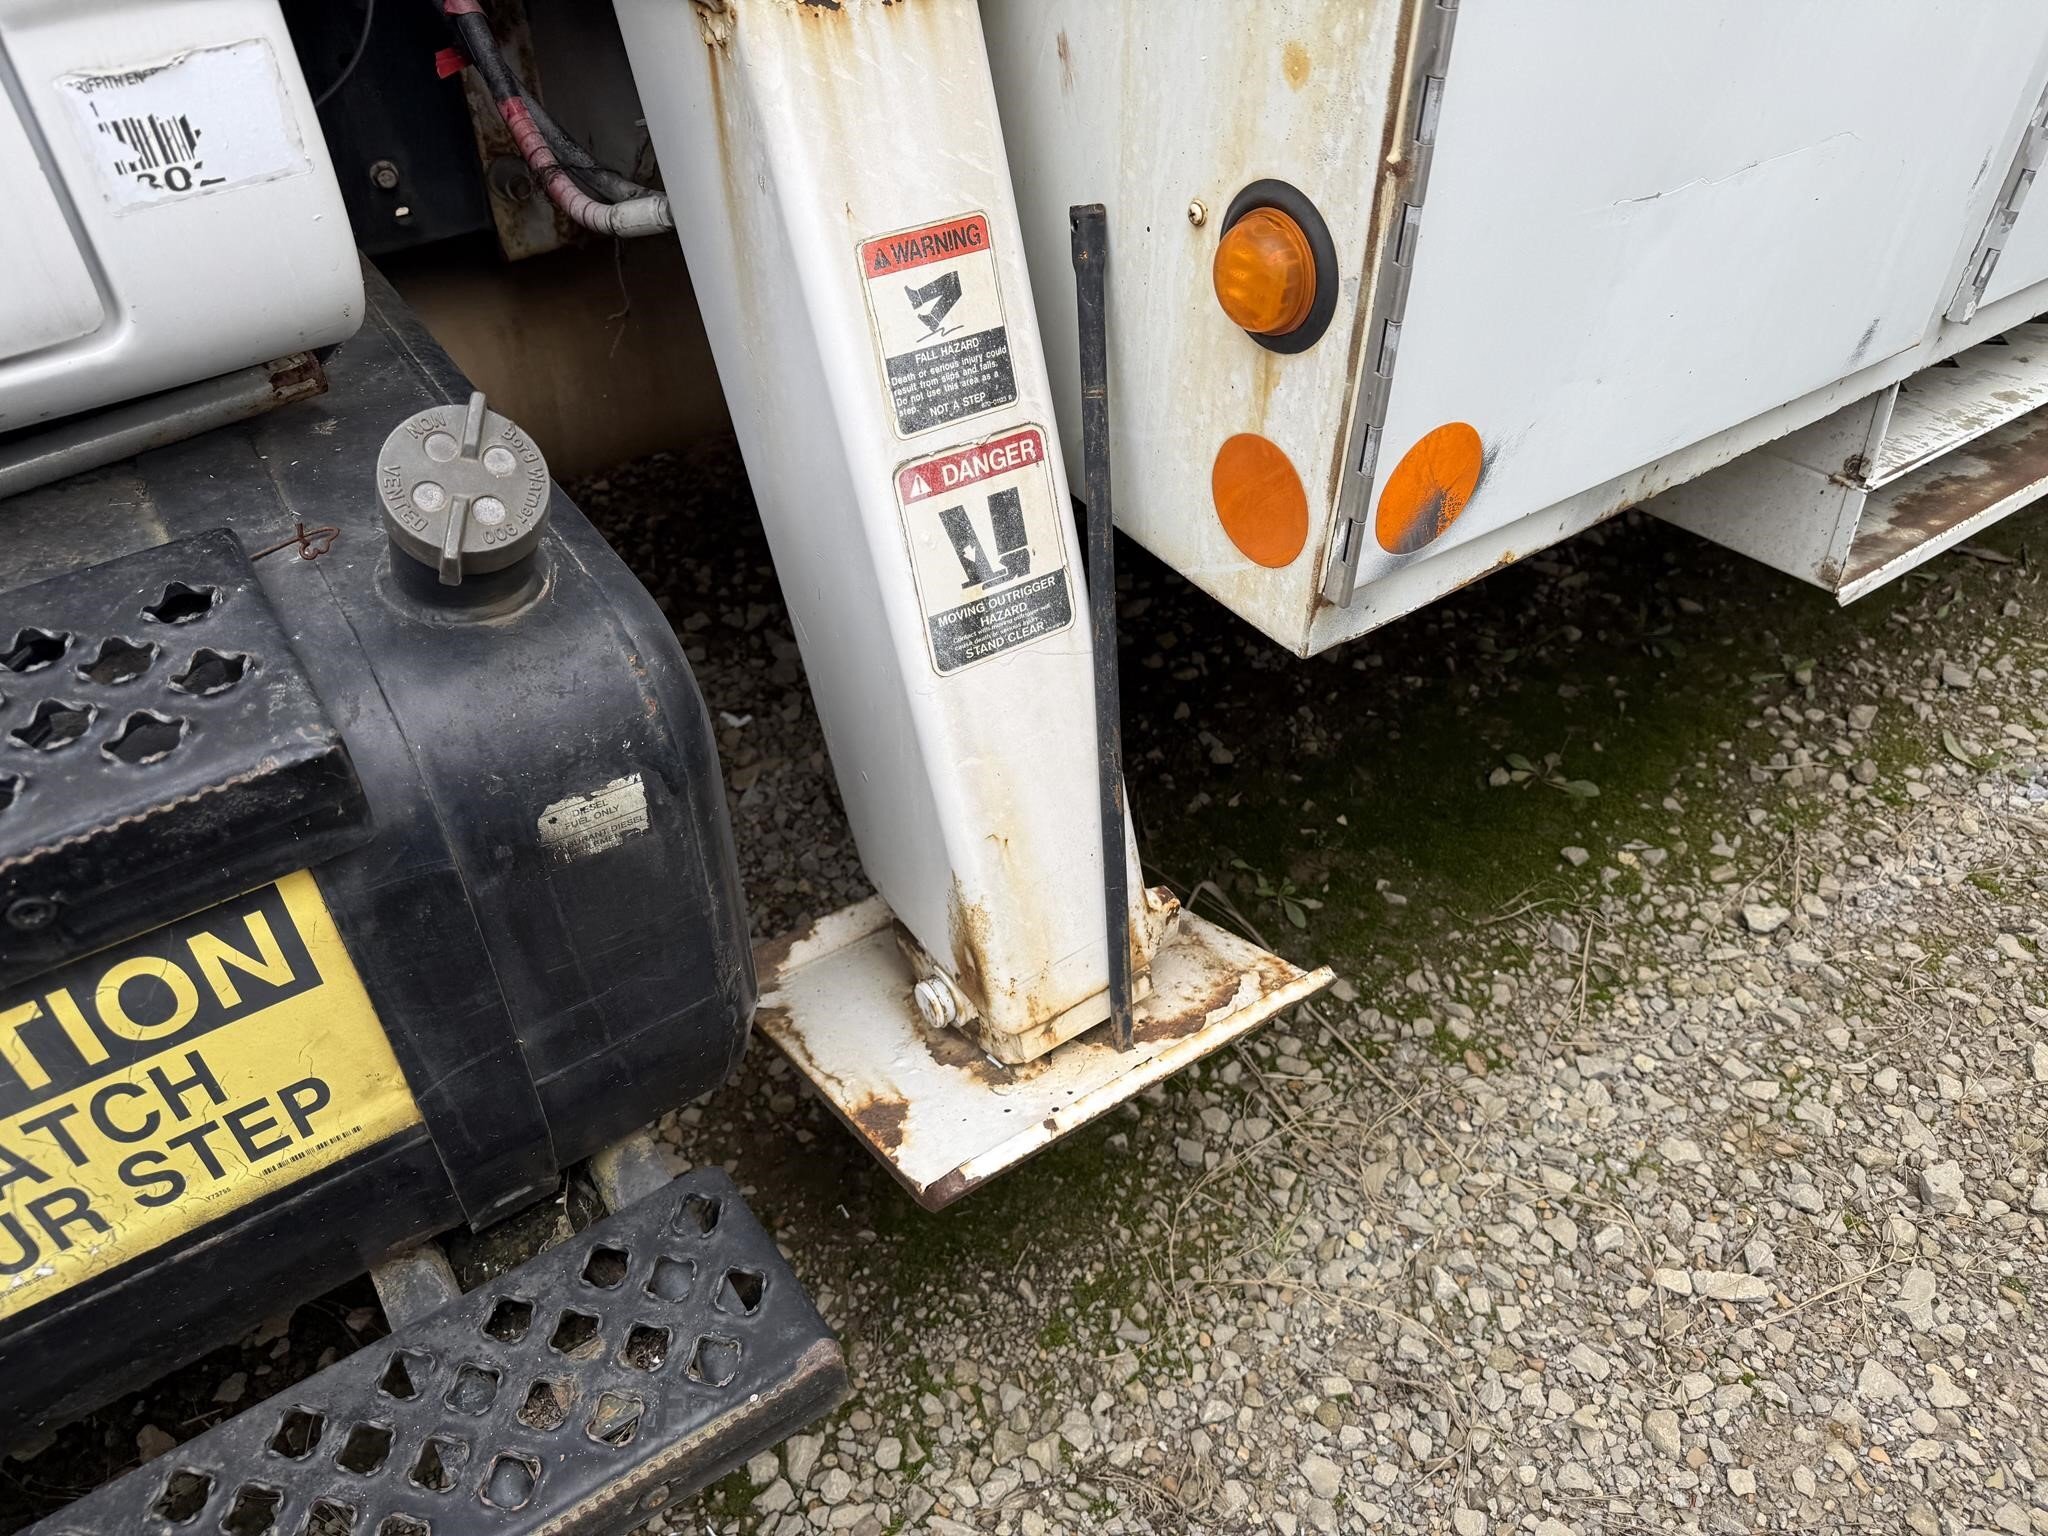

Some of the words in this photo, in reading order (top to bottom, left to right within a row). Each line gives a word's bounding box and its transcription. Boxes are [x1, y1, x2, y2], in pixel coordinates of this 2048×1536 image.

[889, 223, 981, 265] WARNING
[890, 372, 916, 386] Death
[918, 370, 927, 379] or
[930, 360, 960, 375] serious
[961, 353, 983, 367] injury
[986, 345, 1007, 359] could
[914, 350, 938, 364] FALL
[940, 337, 980, 357] HAZARD
[893, 383, 917, 397] result
[919, 378, 939, 390] from
[941, 370, 960, 384] slips
[962, 366, 978, 376] and
[895, 397, 908, 408] Do
[911, 391, 924, 403] not
[926, 388, 941, 398] use
[943, 382, 959, 393] this
[961, 377, 980, 387] area
[898, 406, 920, 418] step.
[929, 402, 949, 417] NOT
[953, 400, 960, 410] A
[961, 391, 986, 407] STEP
[404, 411, 448, 440] NON
[501, 425, 540, 464] Borg
[941, 438, 1037, 487] DANGER
[383, 465, 430, 533] VENTED
[518, 466, 546, 525] Warner
[482, 522, 519, 545] 900
[938, 602, 985, 627] MOVING
[988, 576, 1056, 609] OUTRIGGER
[980, 602, 1028, 627] HAZARD
[965, 637, 1005, 659] STAND
[1007, 622, 1045, 643] CLEAR
[564, 816, 592, 831] FUEL
[593, 804, 620, 820] ONLY
[571, 799, 609, 818] DIESEL
[610, 815, 646, 832] DIESEL
[0, 909, 297, 1092] TION
[117, 1076, 332, 1208] STEP
